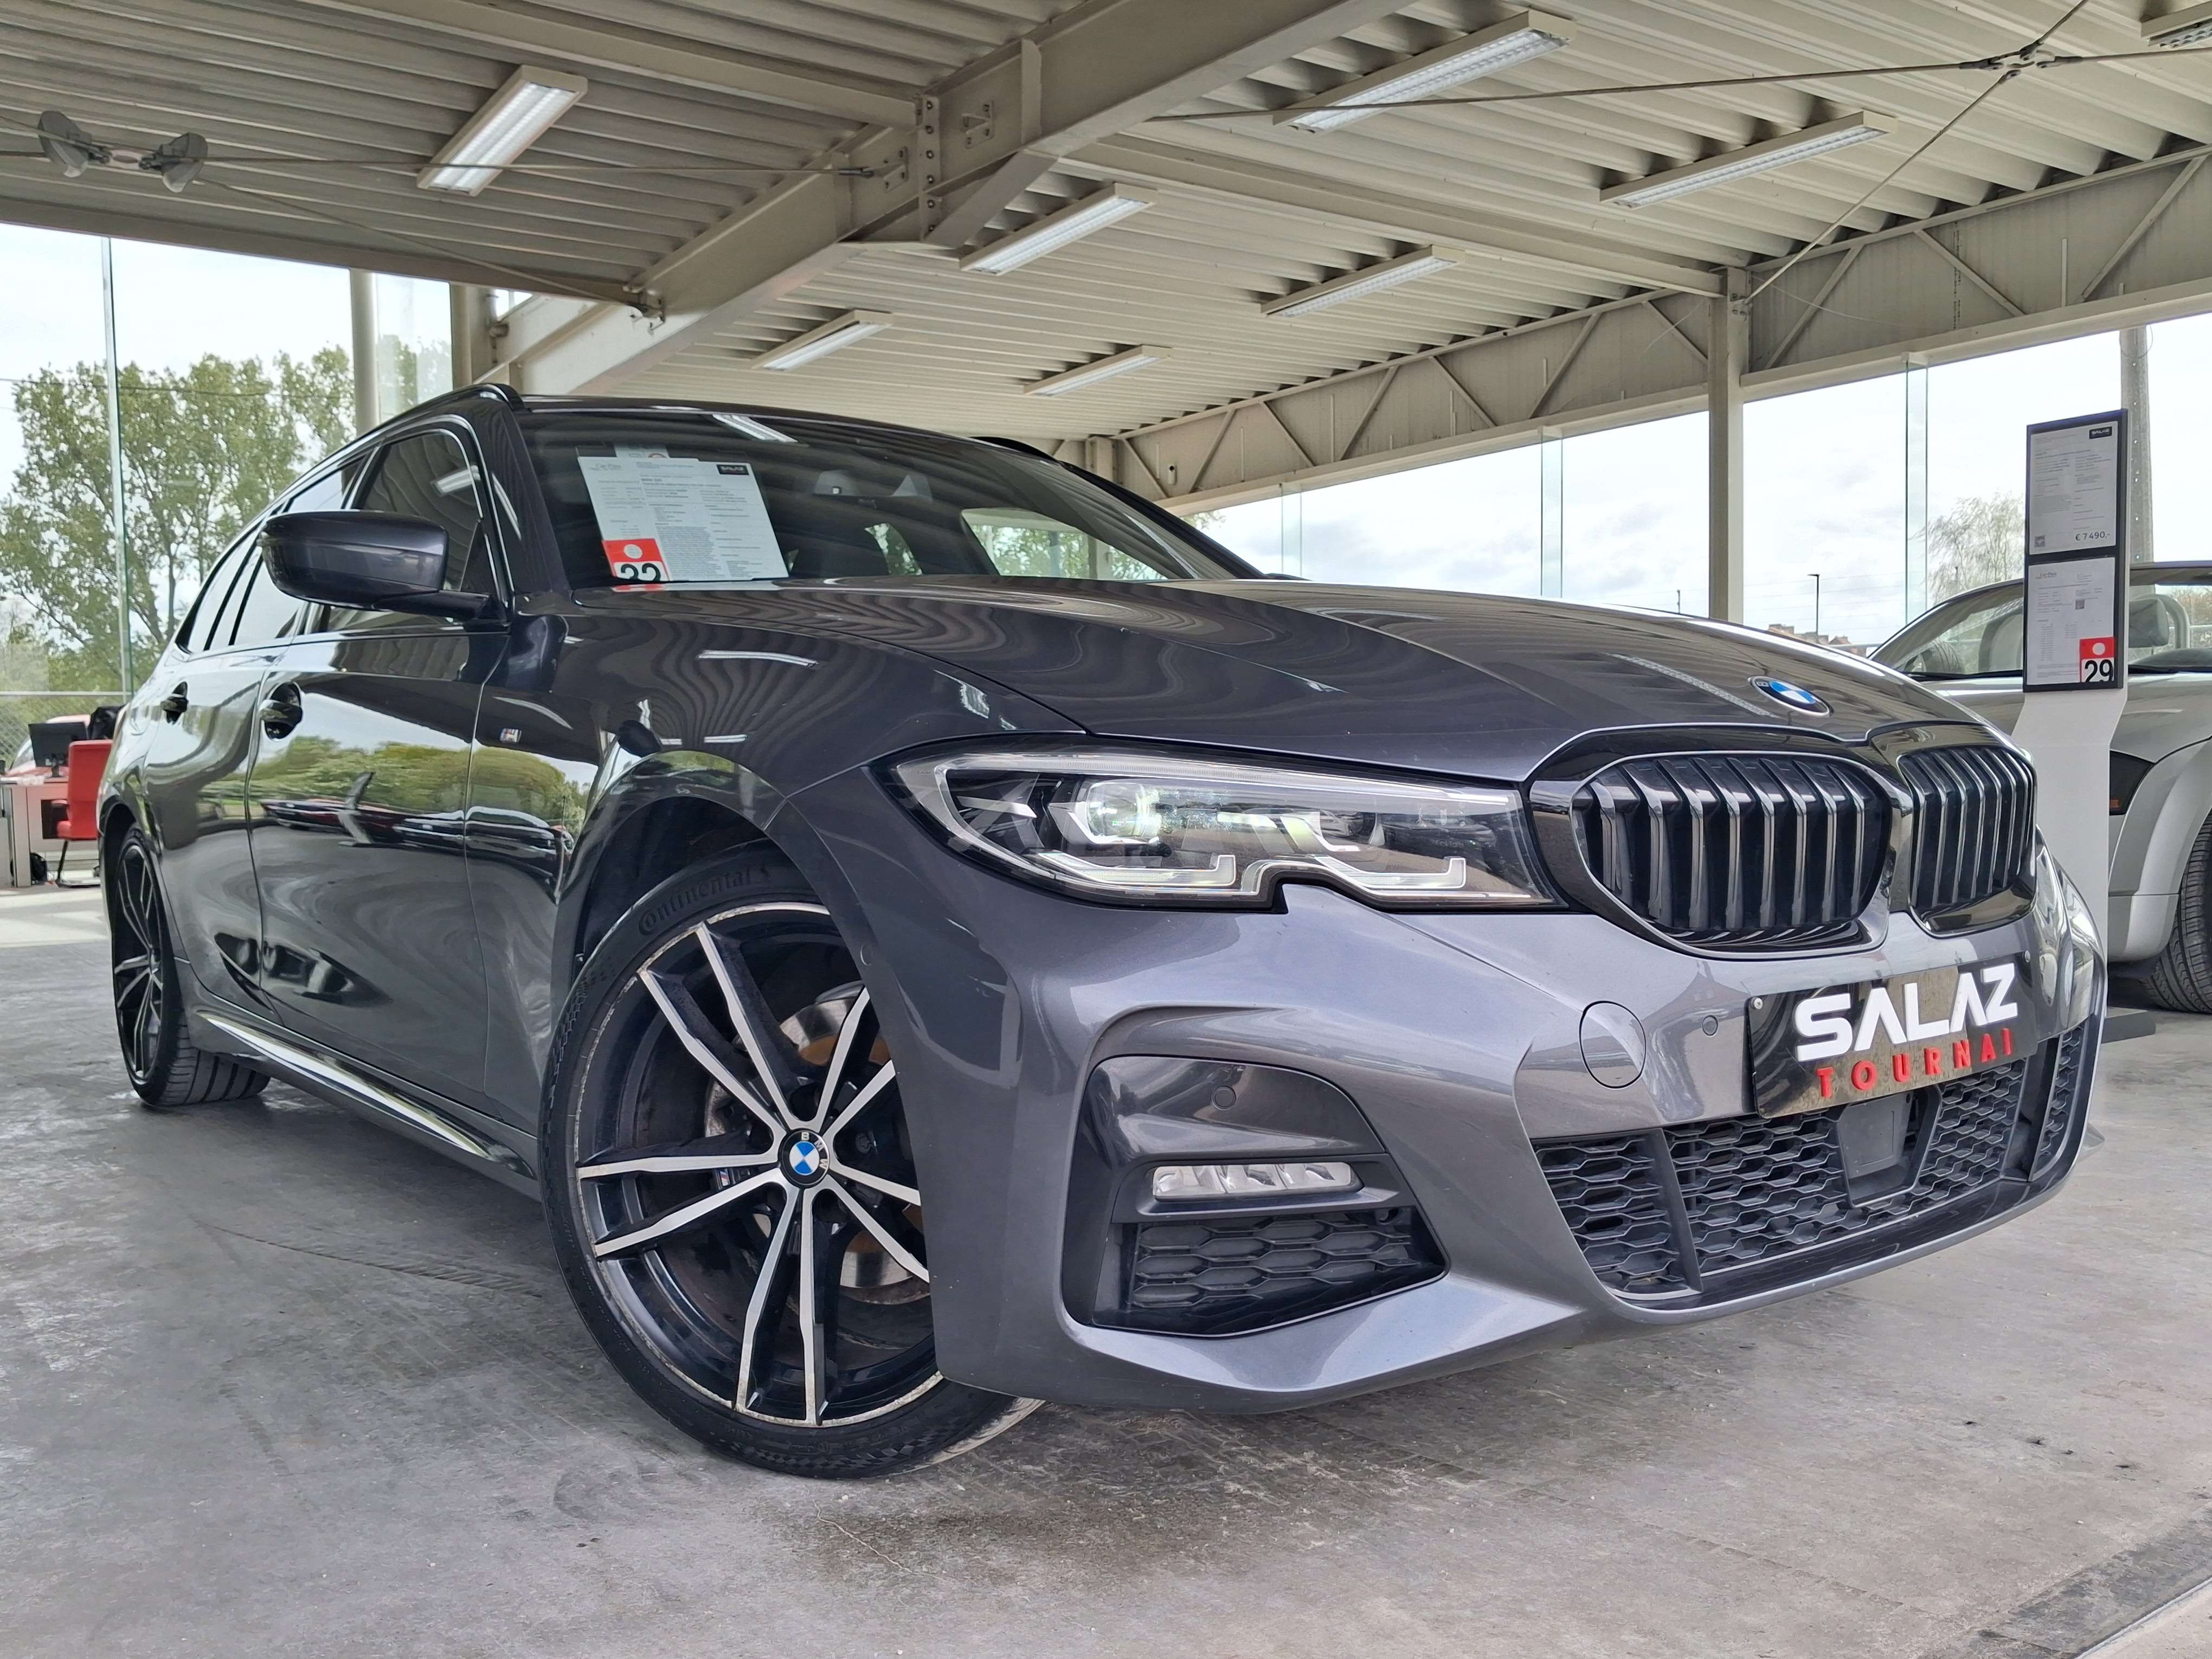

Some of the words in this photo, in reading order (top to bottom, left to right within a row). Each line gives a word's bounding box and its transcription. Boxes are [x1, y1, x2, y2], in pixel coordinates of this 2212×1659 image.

[2085, 659, 2114, 683] 29
[638, 867, 751, 936] Continental
[1795, 962, 2018, 1062] SALAZ
[1816, 1028, 2012, 1098] TOURNAI
[801, 1132, 828, 1169] BMW
